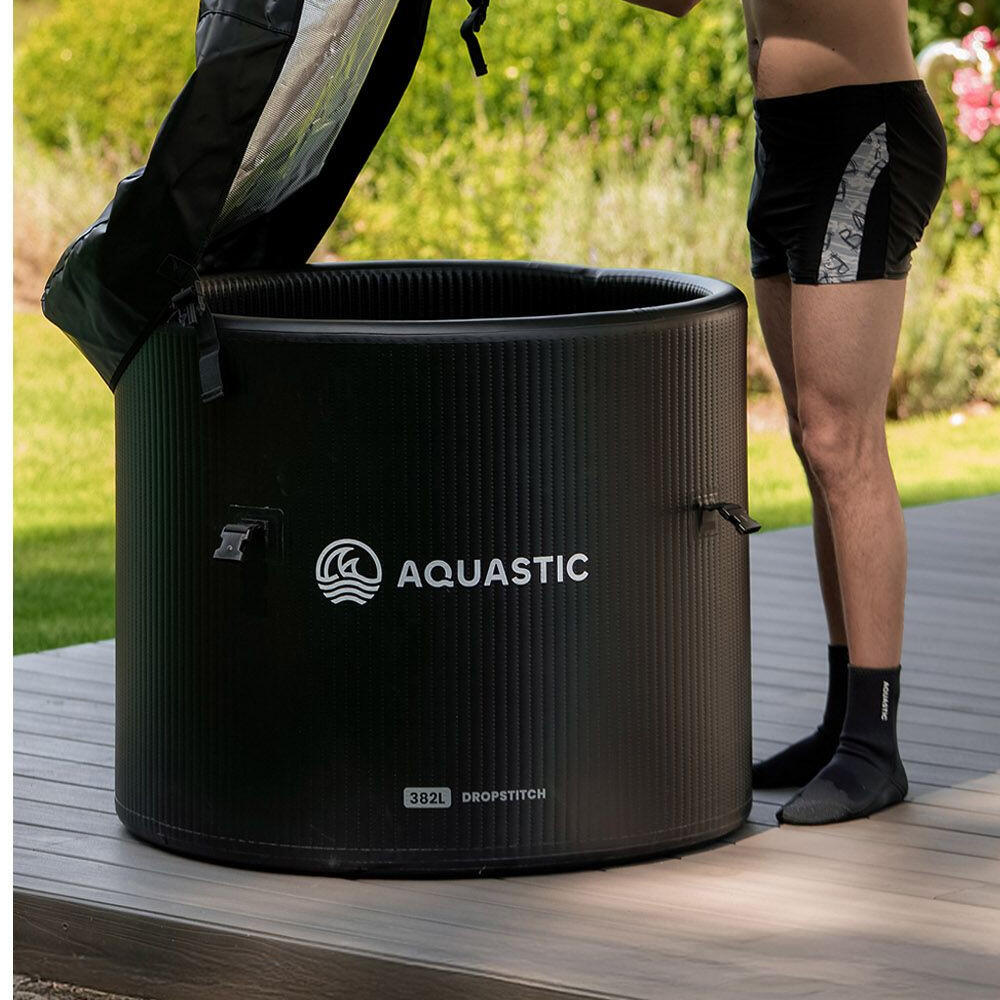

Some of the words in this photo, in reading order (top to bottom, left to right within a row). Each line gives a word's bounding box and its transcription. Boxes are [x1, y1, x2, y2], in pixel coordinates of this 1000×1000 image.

[397, 553, 590, 588] AQUASTIC
[409, 791, 446, 806] 382L
[461, 788, 547, 803] DROPSTITCH
